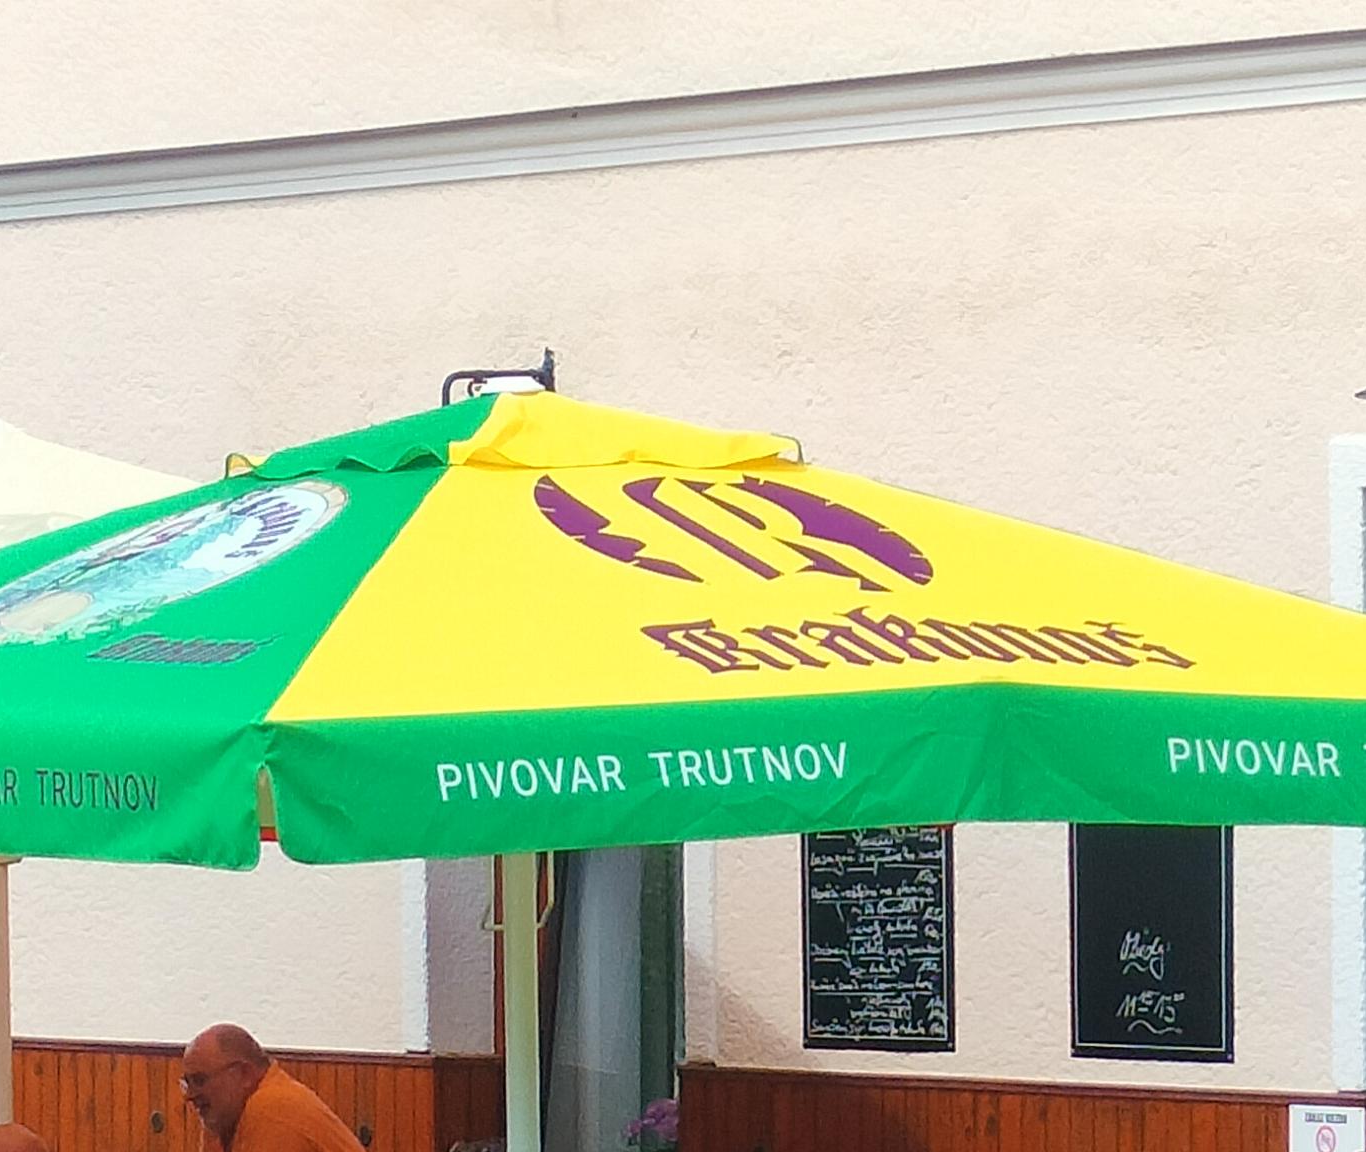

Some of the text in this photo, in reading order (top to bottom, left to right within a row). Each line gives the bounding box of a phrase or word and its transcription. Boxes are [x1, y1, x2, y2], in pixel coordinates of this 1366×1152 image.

[436, 742, 848, 801] PIVOVAR TRUTNOV
[1167, 737, 1341, 779] PIVOVAR
[35, 768, 159, 812] TRUTNOV
